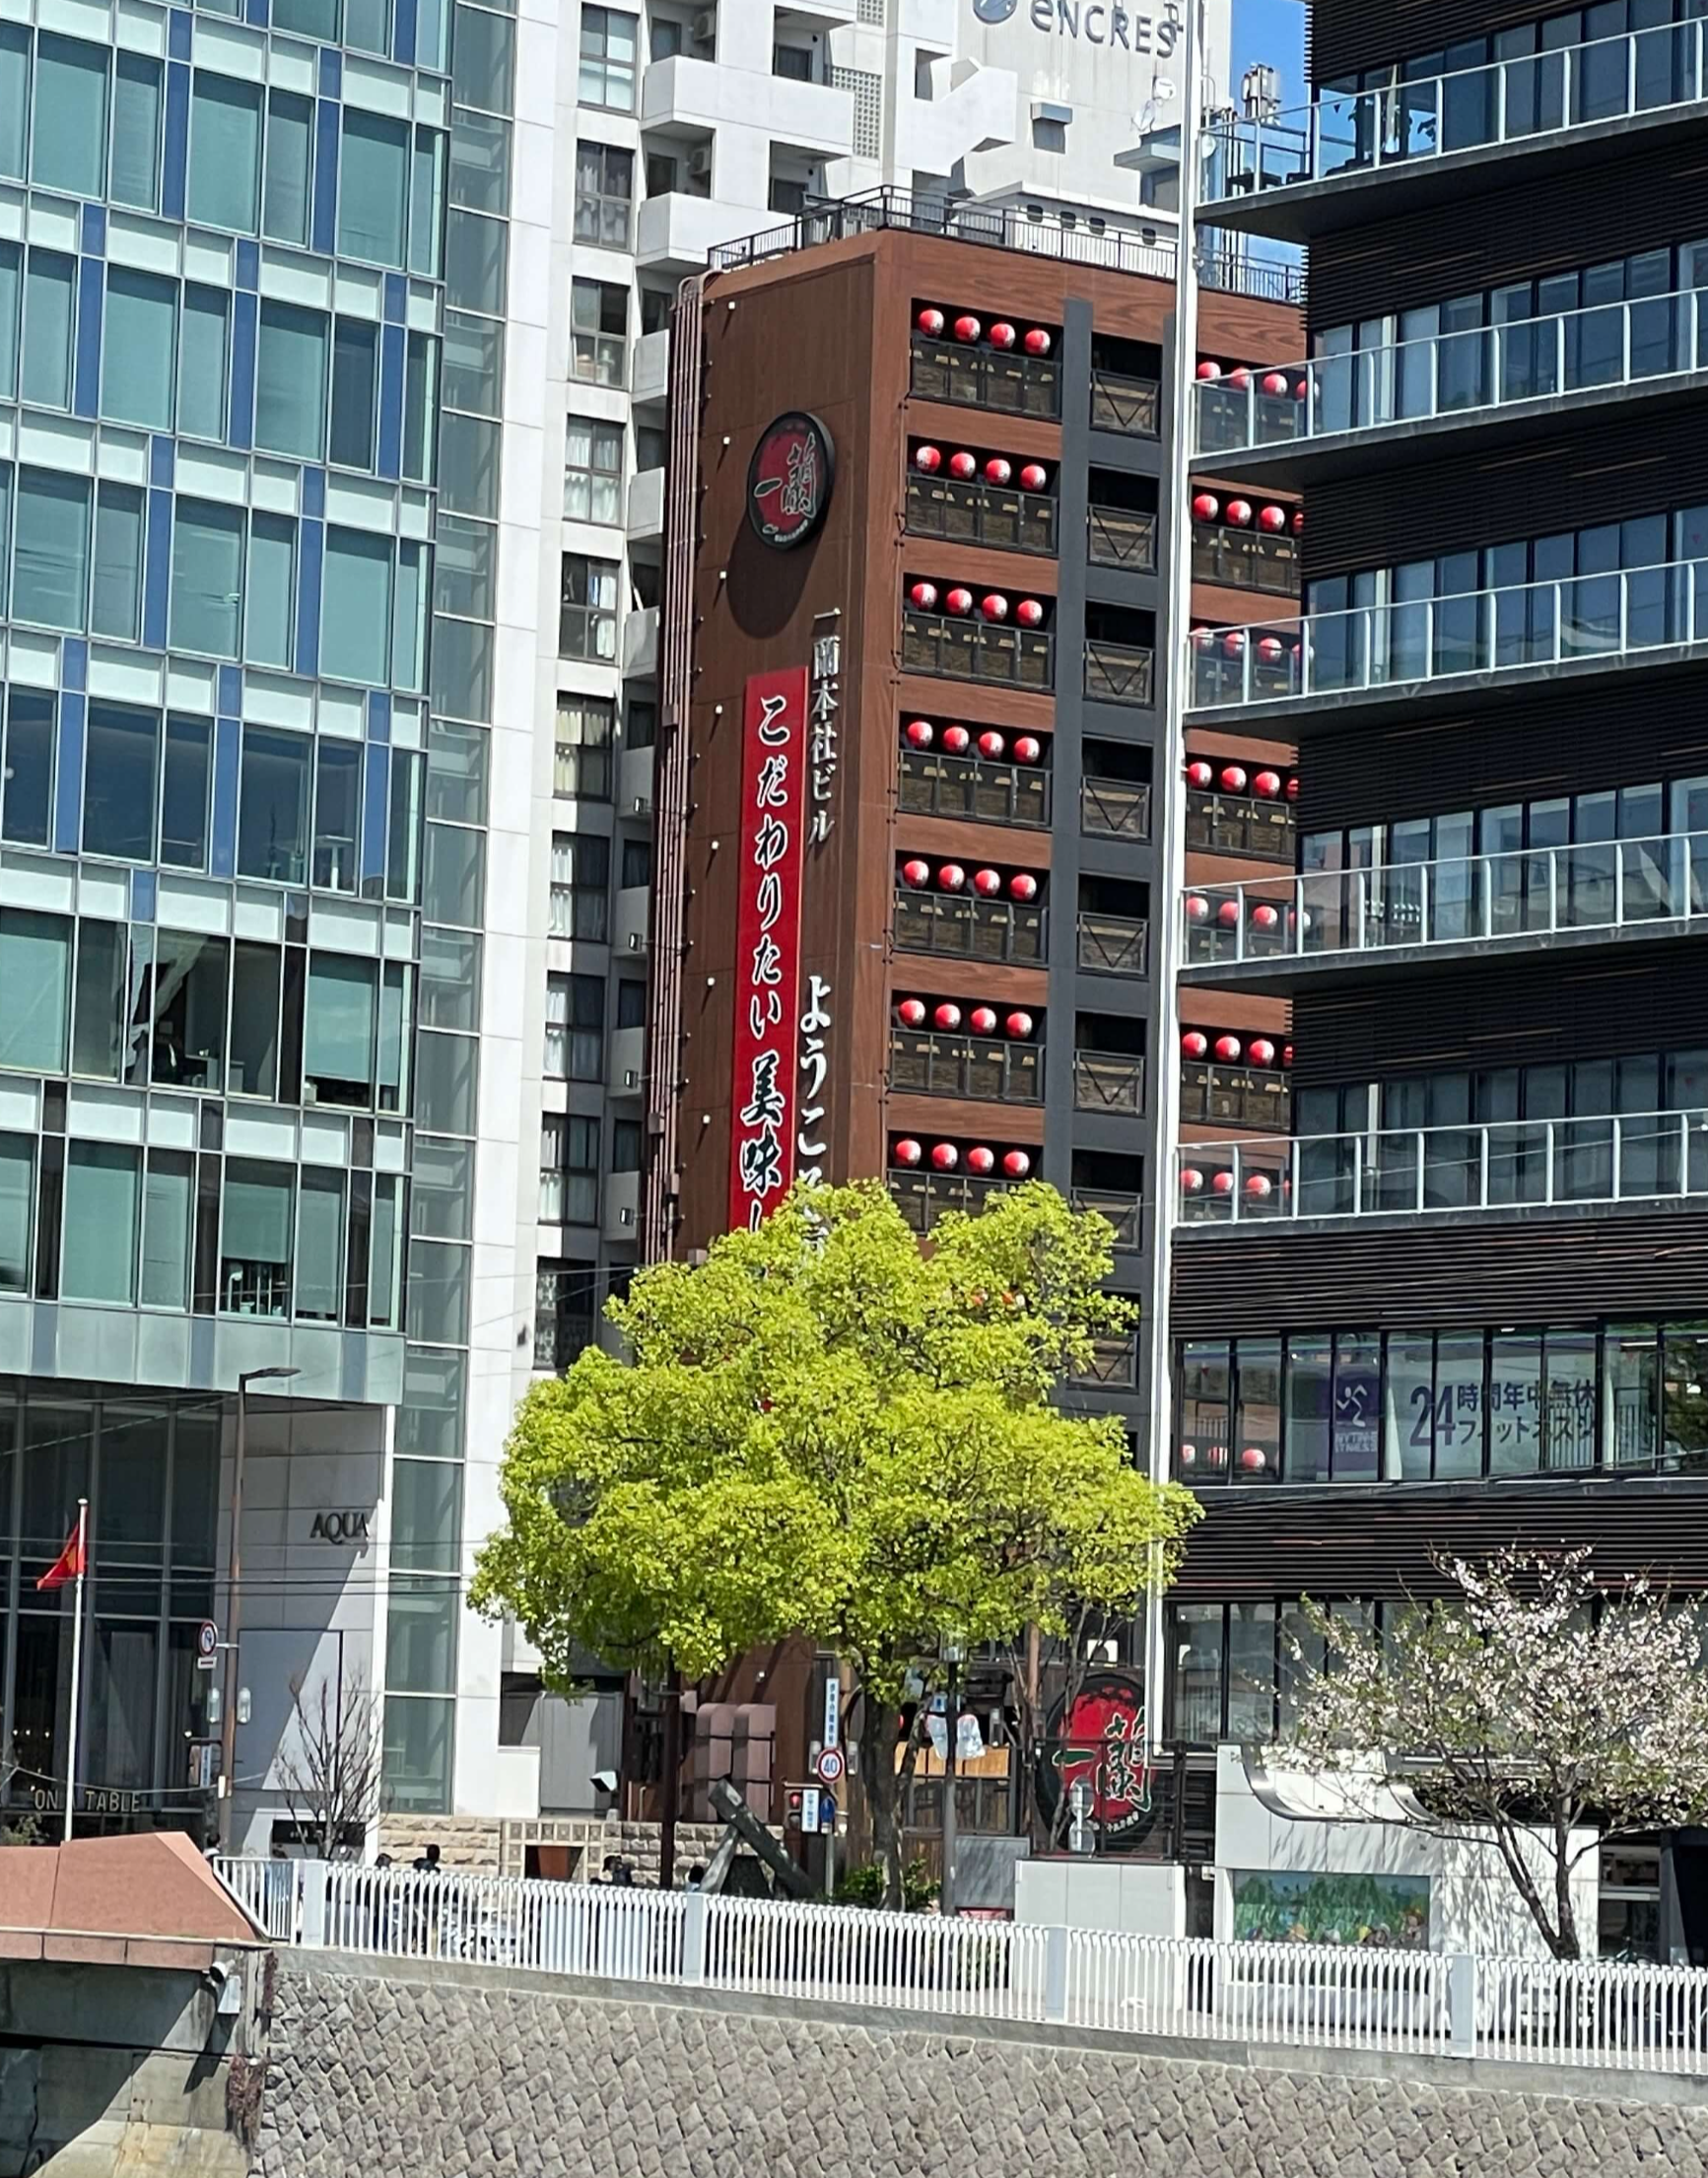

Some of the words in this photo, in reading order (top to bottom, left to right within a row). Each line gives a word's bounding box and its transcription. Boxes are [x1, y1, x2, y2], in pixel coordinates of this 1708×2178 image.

[754, 432, 816, 518] 一蘭
[309, 1511, 369, 1545] AQUA
[823, 1757, 838, 1774] 40
[34, 1789, 58, 1810] ON
[85, 1790, 140, 1812] TABLE
